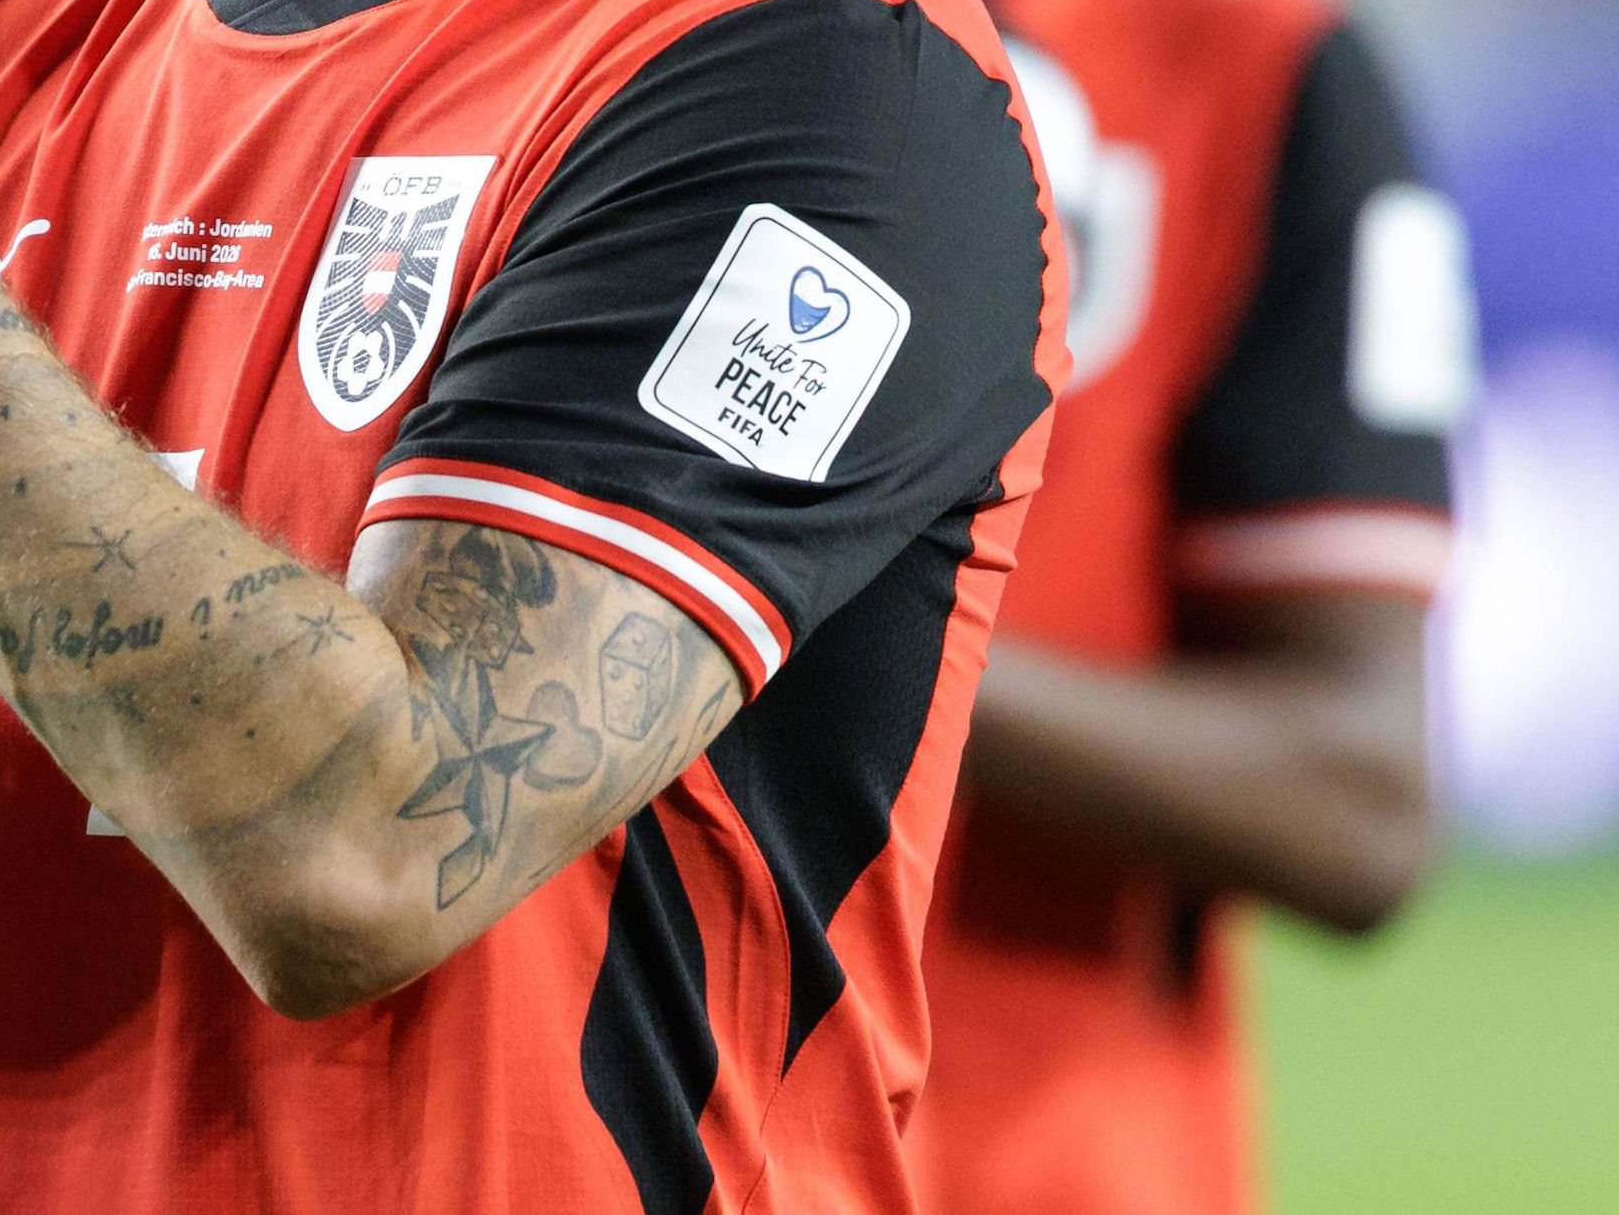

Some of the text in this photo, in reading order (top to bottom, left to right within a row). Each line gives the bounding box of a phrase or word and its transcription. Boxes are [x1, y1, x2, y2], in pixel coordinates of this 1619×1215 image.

[383, 172, 443, 196] ÖFB
[165, 242, 207, 263] Juni
[732, 318, 827, 396] Unite For
[714, 357, 807, 436] PEACE
[718, 407, 765, 447] FIFA
